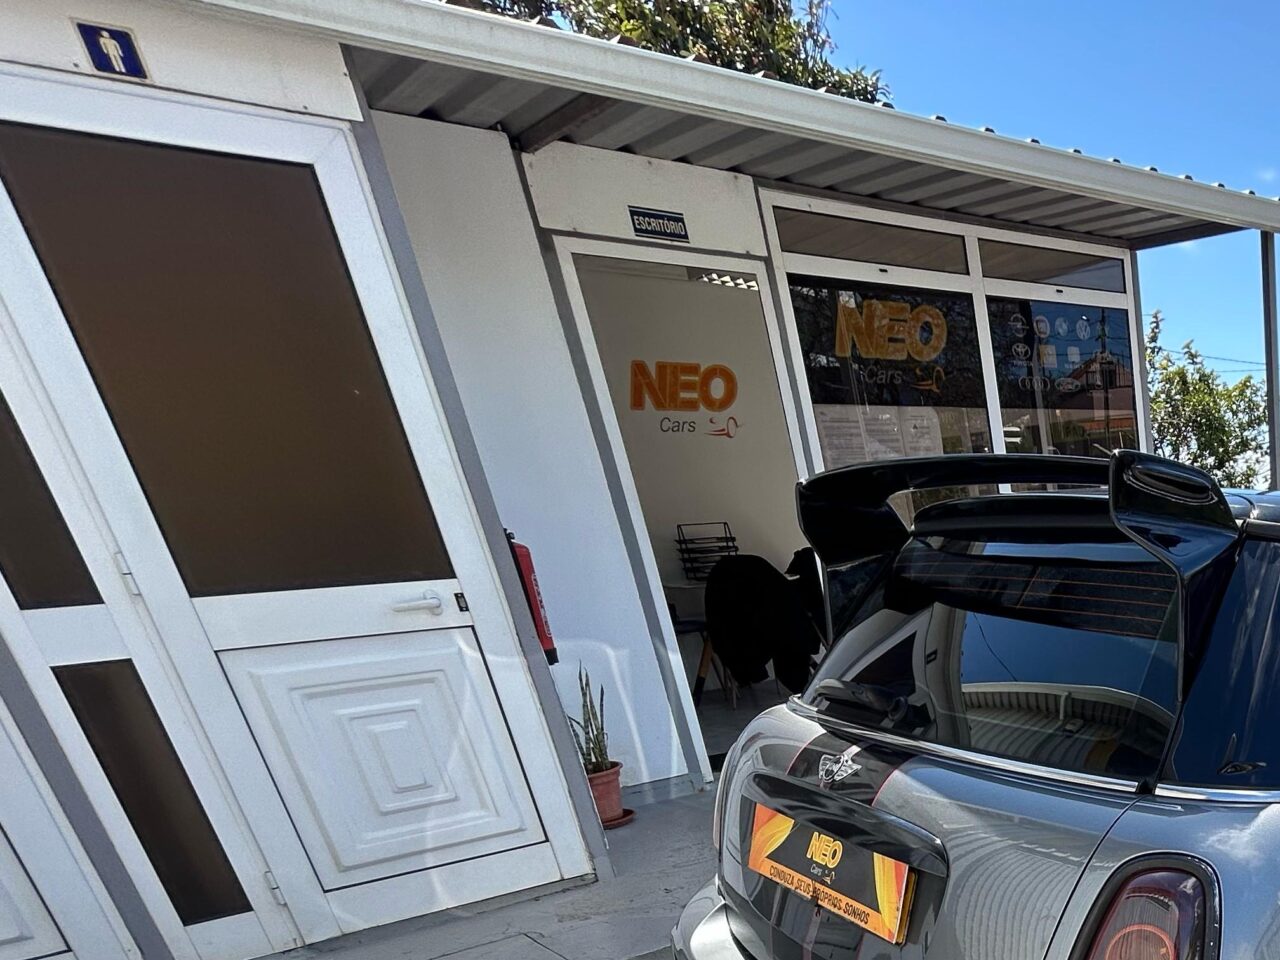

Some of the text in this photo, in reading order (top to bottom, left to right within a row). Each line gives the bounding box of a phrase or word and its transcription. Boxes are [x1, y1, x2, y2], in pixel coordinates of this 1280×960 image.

[633, 215, 686, 235] ESCRITÓRIO
[835, 297, 948, 362] NEO
[629, 359, 739, 413] NEO
[865, 365, 903, 385] Cars
[659, 416, 697, 434] Cars
[806, 831, 843, 868] NEO
[810, 863, 823, 876] Cars
[770, 865, 794, 885] CONDUZA
[796, 879, 811, 895] SEUS
[844, 902, 869, 923] SONHOS
